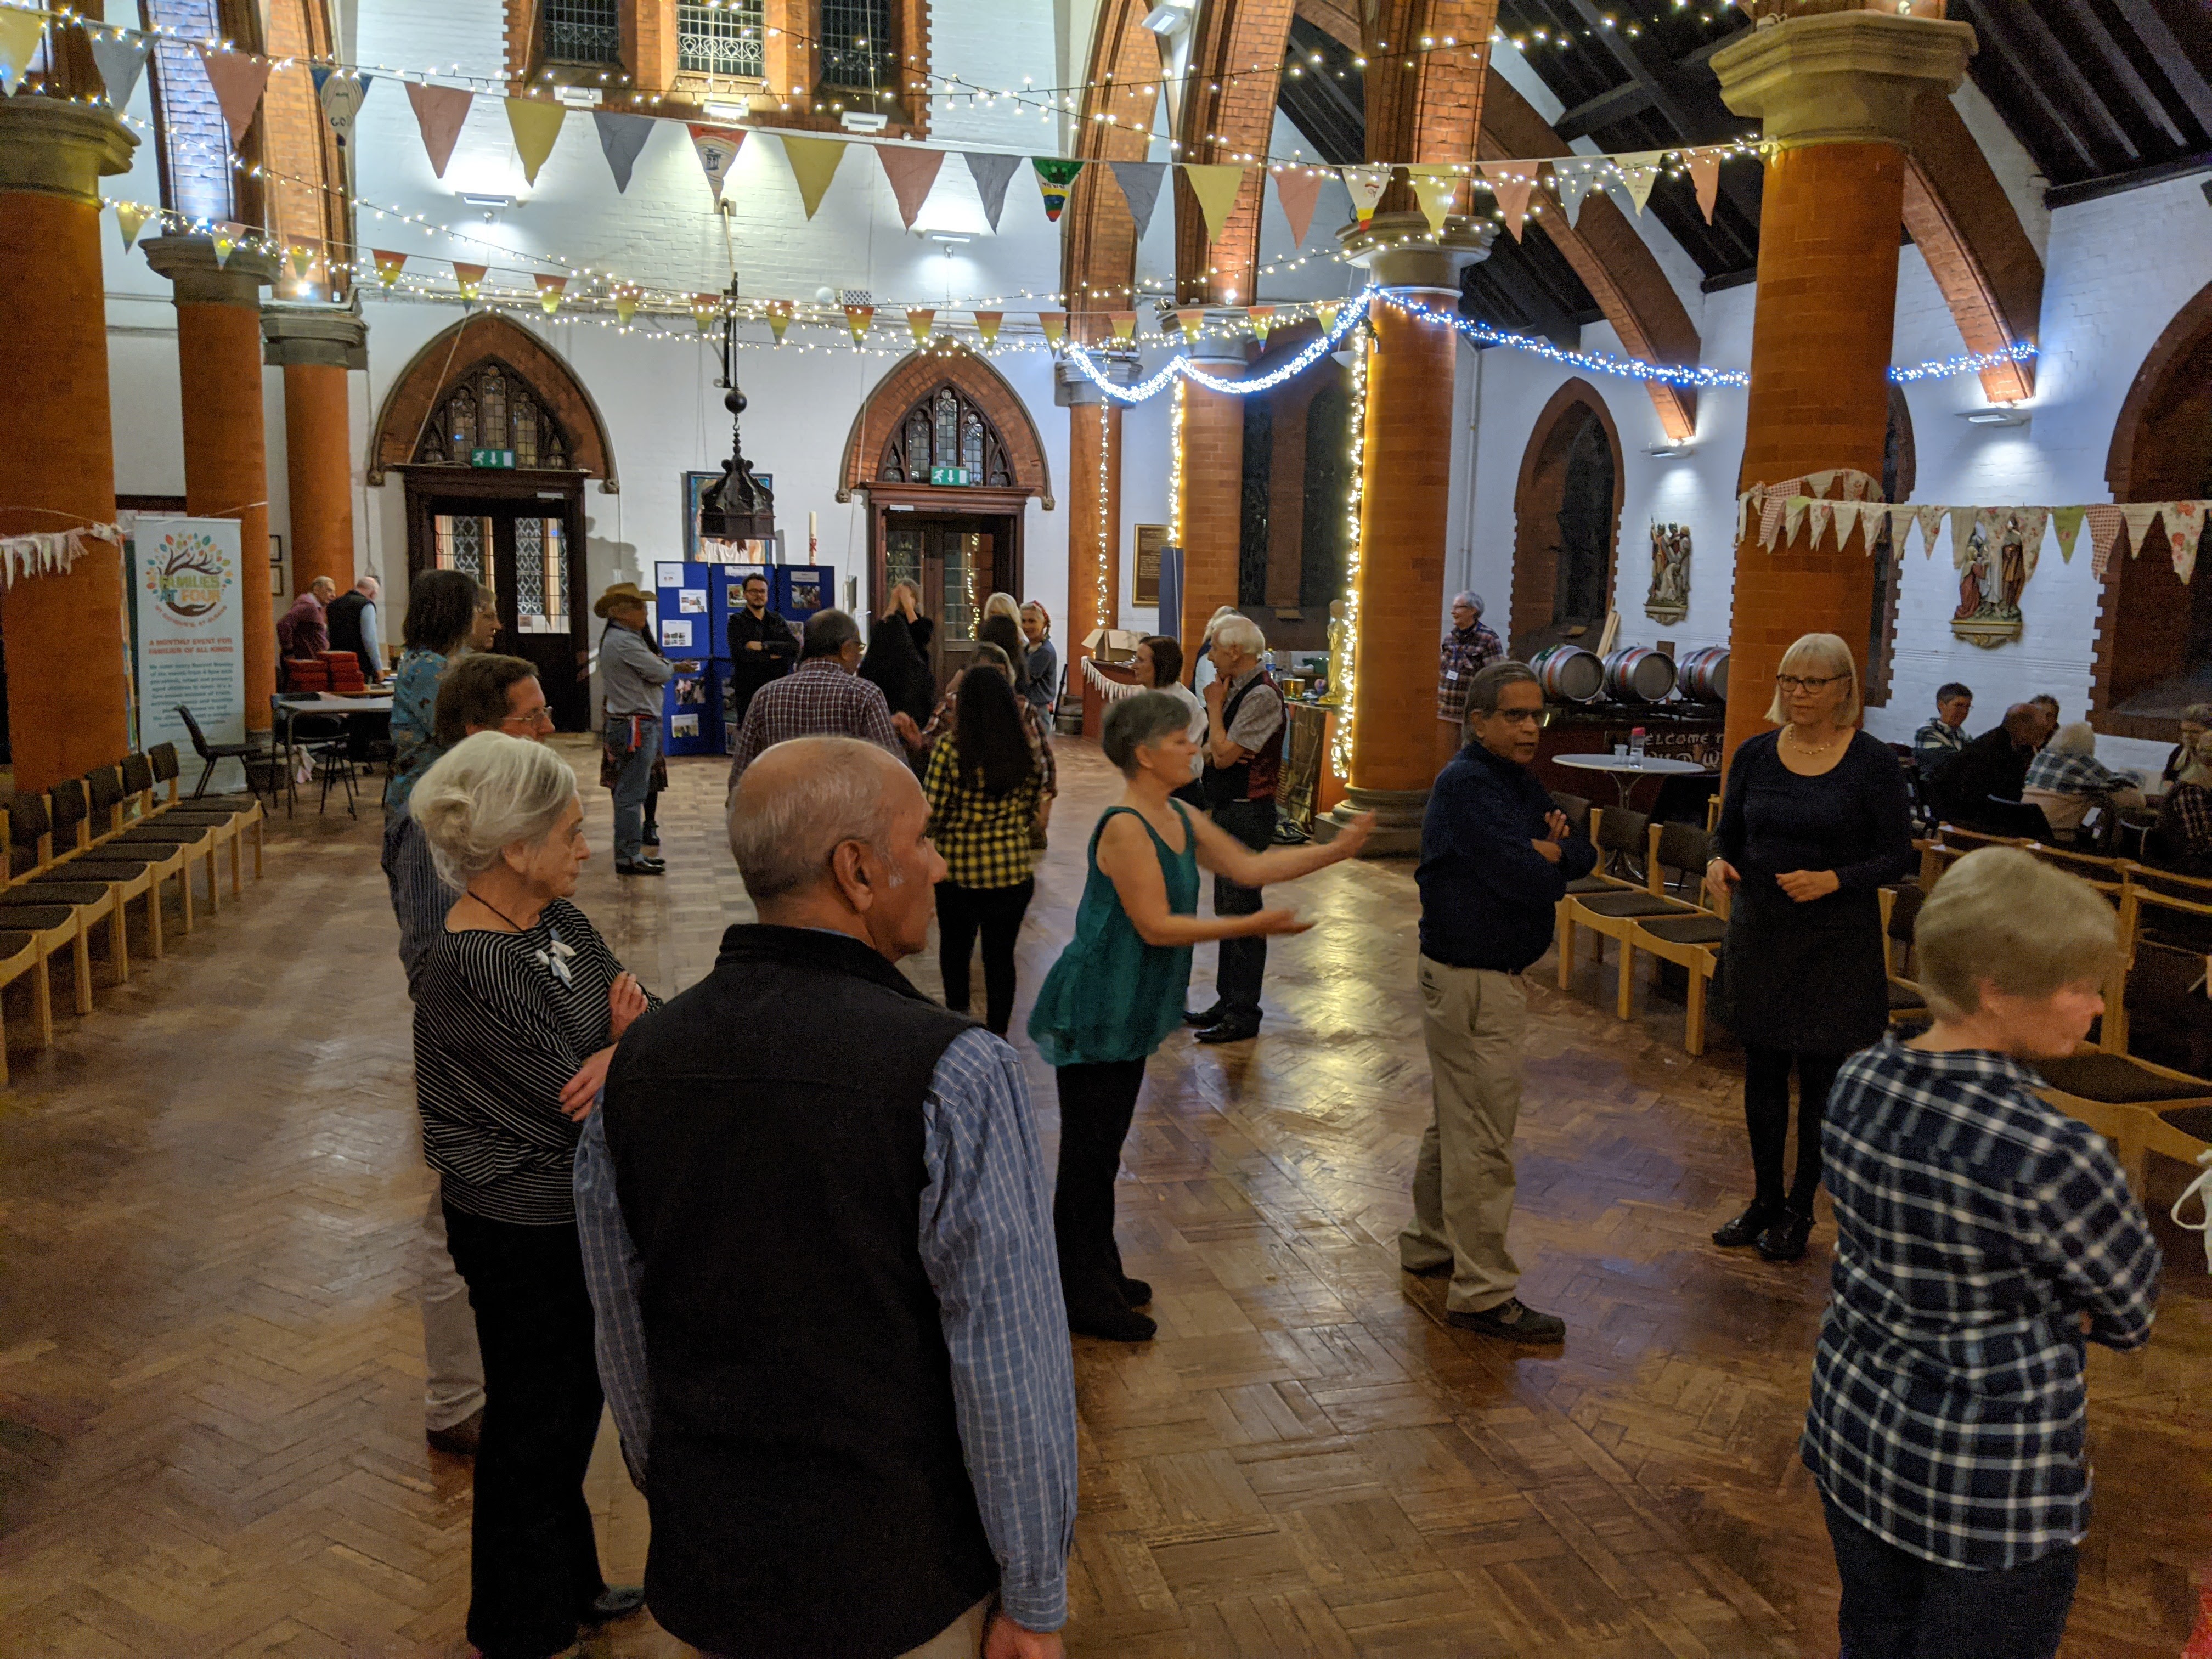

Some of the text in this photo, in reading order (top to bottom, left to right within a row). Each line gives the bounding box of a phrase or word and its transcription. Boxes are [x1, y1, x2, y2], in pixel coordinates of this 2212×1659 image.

[159, 575, 221, 589] FAMILIES
[160, 589, 221, 602] AT FOUR
[1644, 732, 1710, 746] ELCOME
